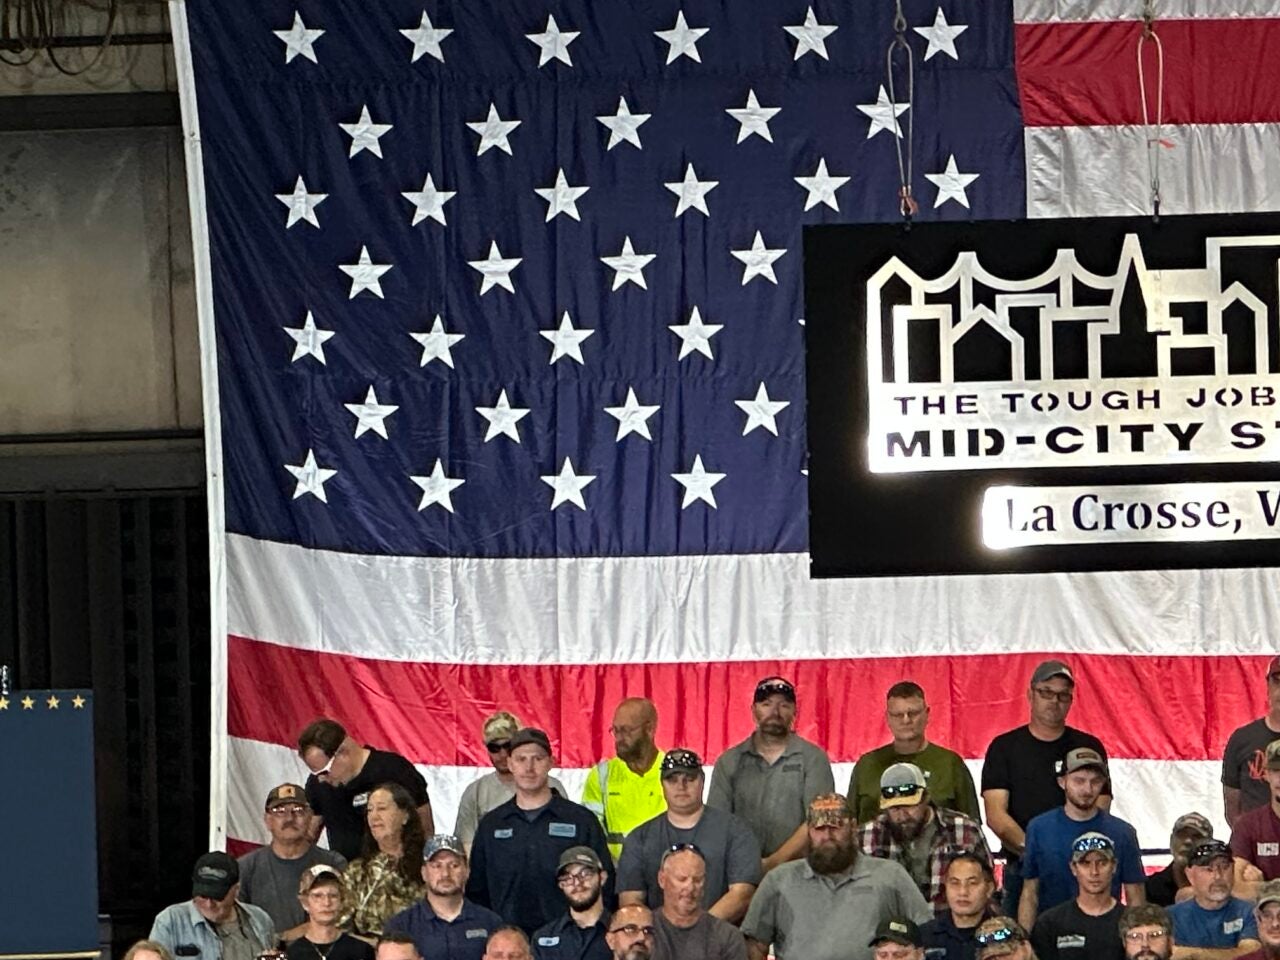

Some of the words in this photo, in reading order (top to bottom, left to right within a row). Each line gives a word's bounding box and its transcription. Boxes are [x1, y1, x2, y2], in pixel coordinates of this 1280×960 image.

[894, 394, 979, 415] THE
[1001, 389, 1161, 413] TOUGH
[1186, 386, 1277, 408] JOB
[886, 422, 1204, 457] MID-CITY
[1006, 498, 1057, 532] La
[1072, 494, 1242, 534] Crosse,
